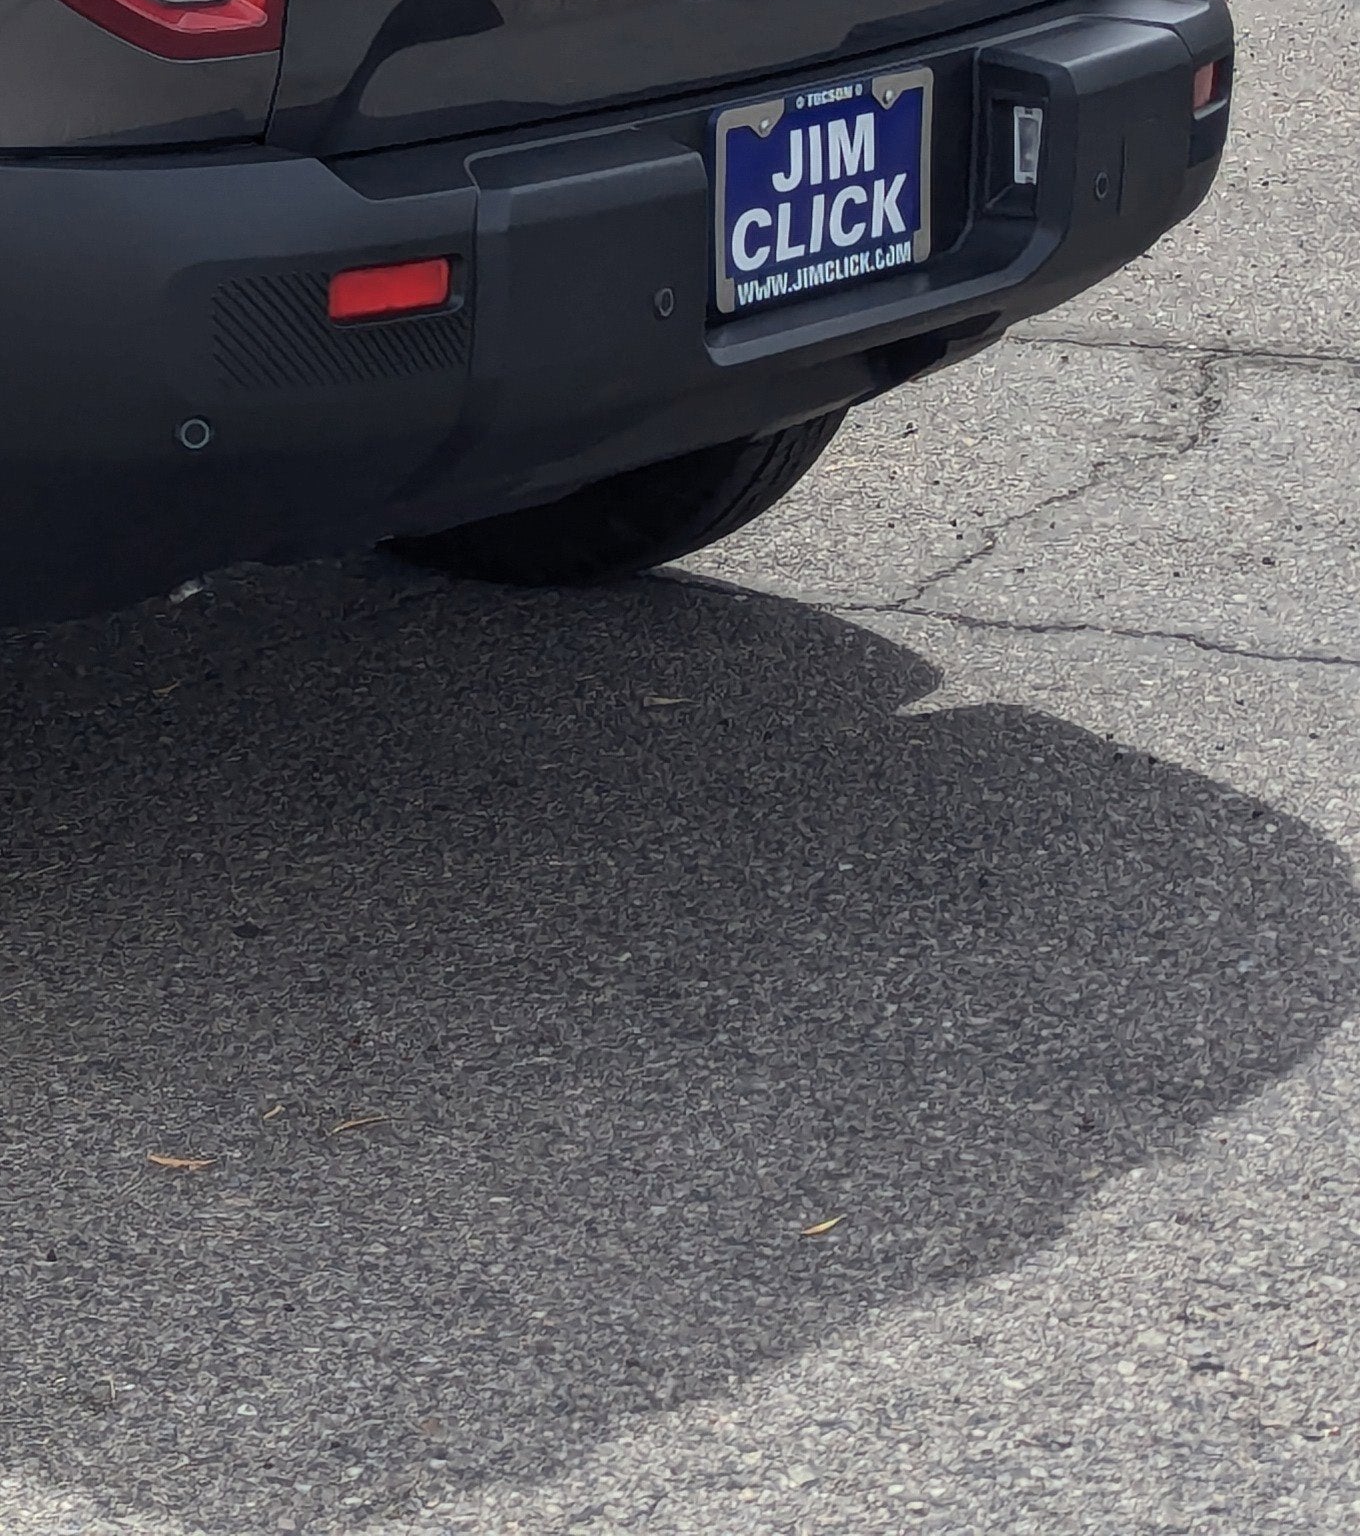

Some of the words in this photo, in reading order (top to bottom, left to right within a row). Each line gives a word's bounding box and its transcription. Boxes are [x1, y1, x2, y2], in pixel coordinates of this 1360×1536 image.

[771, 111, 876, 193] JIM
[731, 172, 908, 272] CLICK
[737, 240, 912, 306] WWW.JIMCLICK.COM
